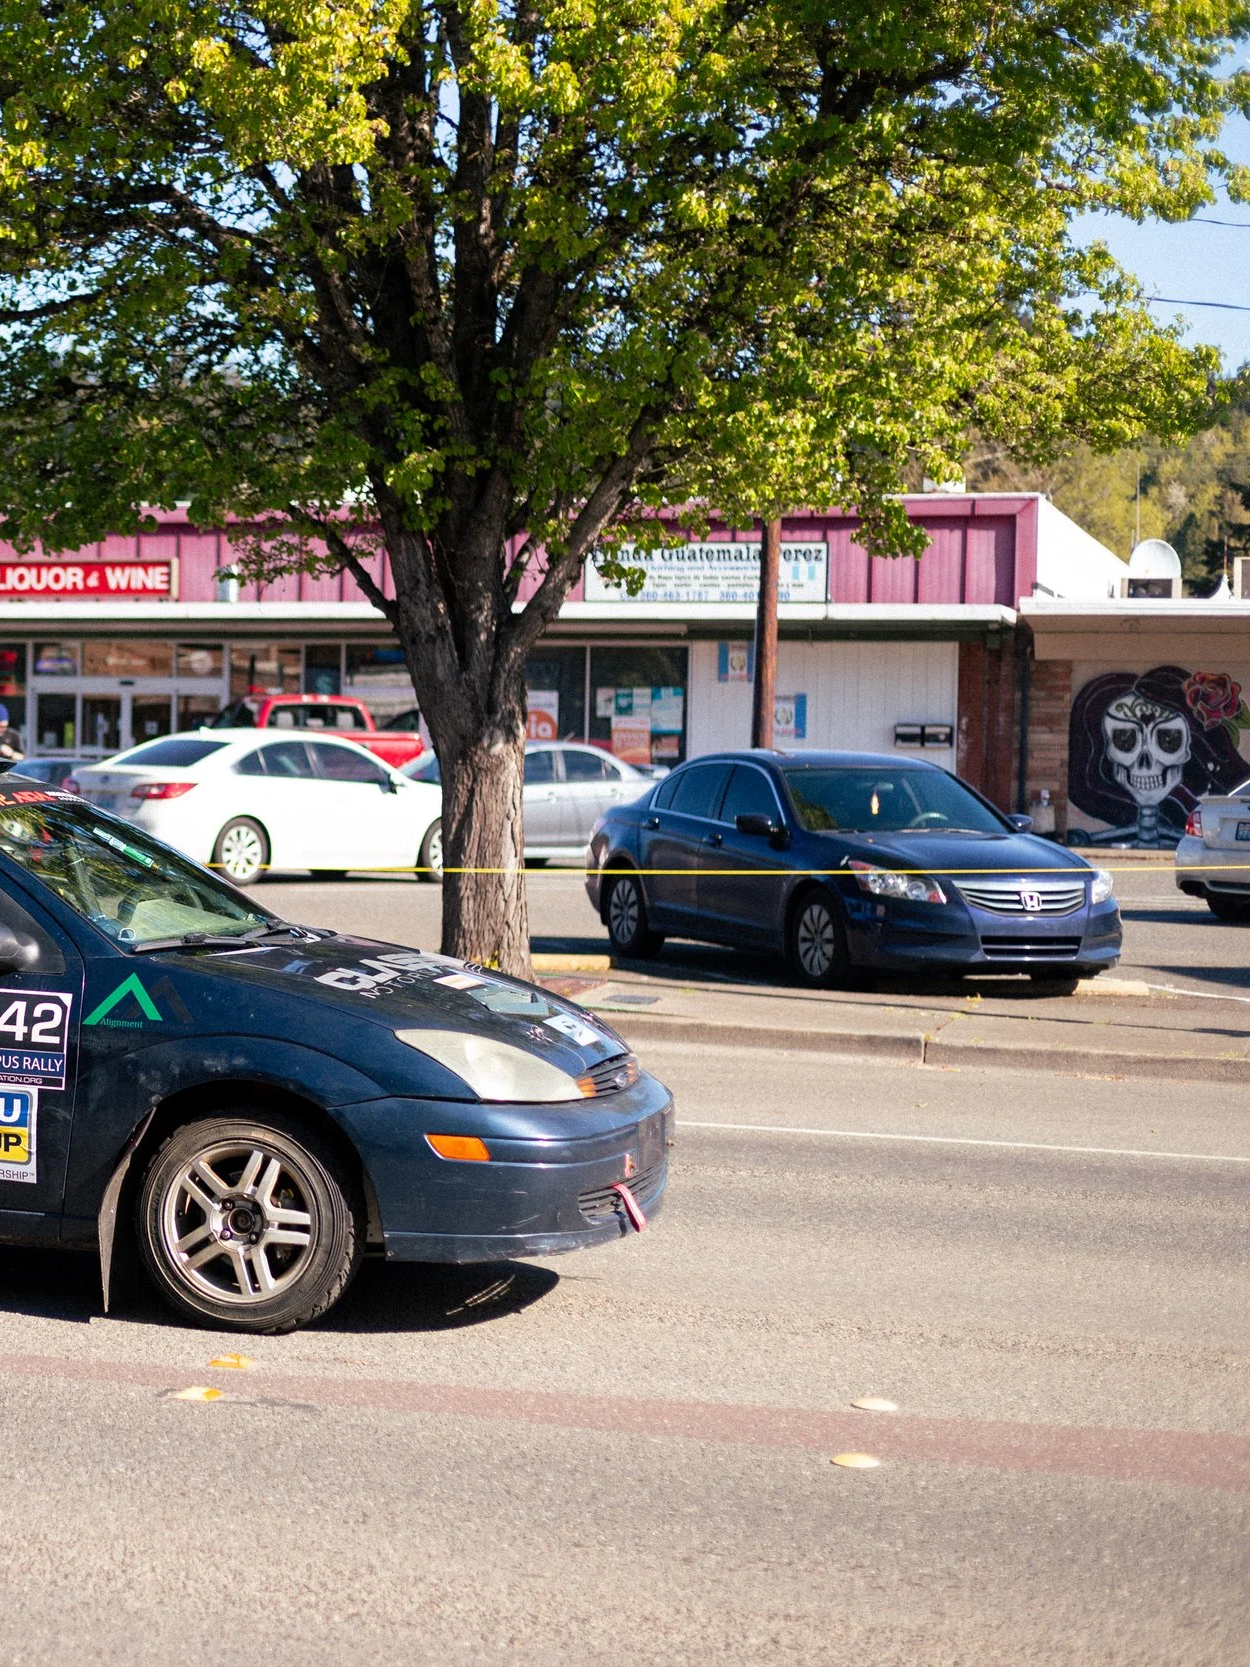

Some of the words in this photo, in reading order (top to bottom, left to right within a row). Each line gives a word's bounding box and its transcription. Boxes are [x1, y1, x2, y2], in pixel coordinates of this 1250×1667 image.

[661, 546, 761, 562] Guatemala
[778, 548, 823, 562] erez
[86, 570, 99, 588] &
[105, 566, 169, 591] WINE
[526, 713, 553, 738] ia
[99, 1018, 144, 1029] Alignment
[24, 1056, 63, 1072] RALLY
